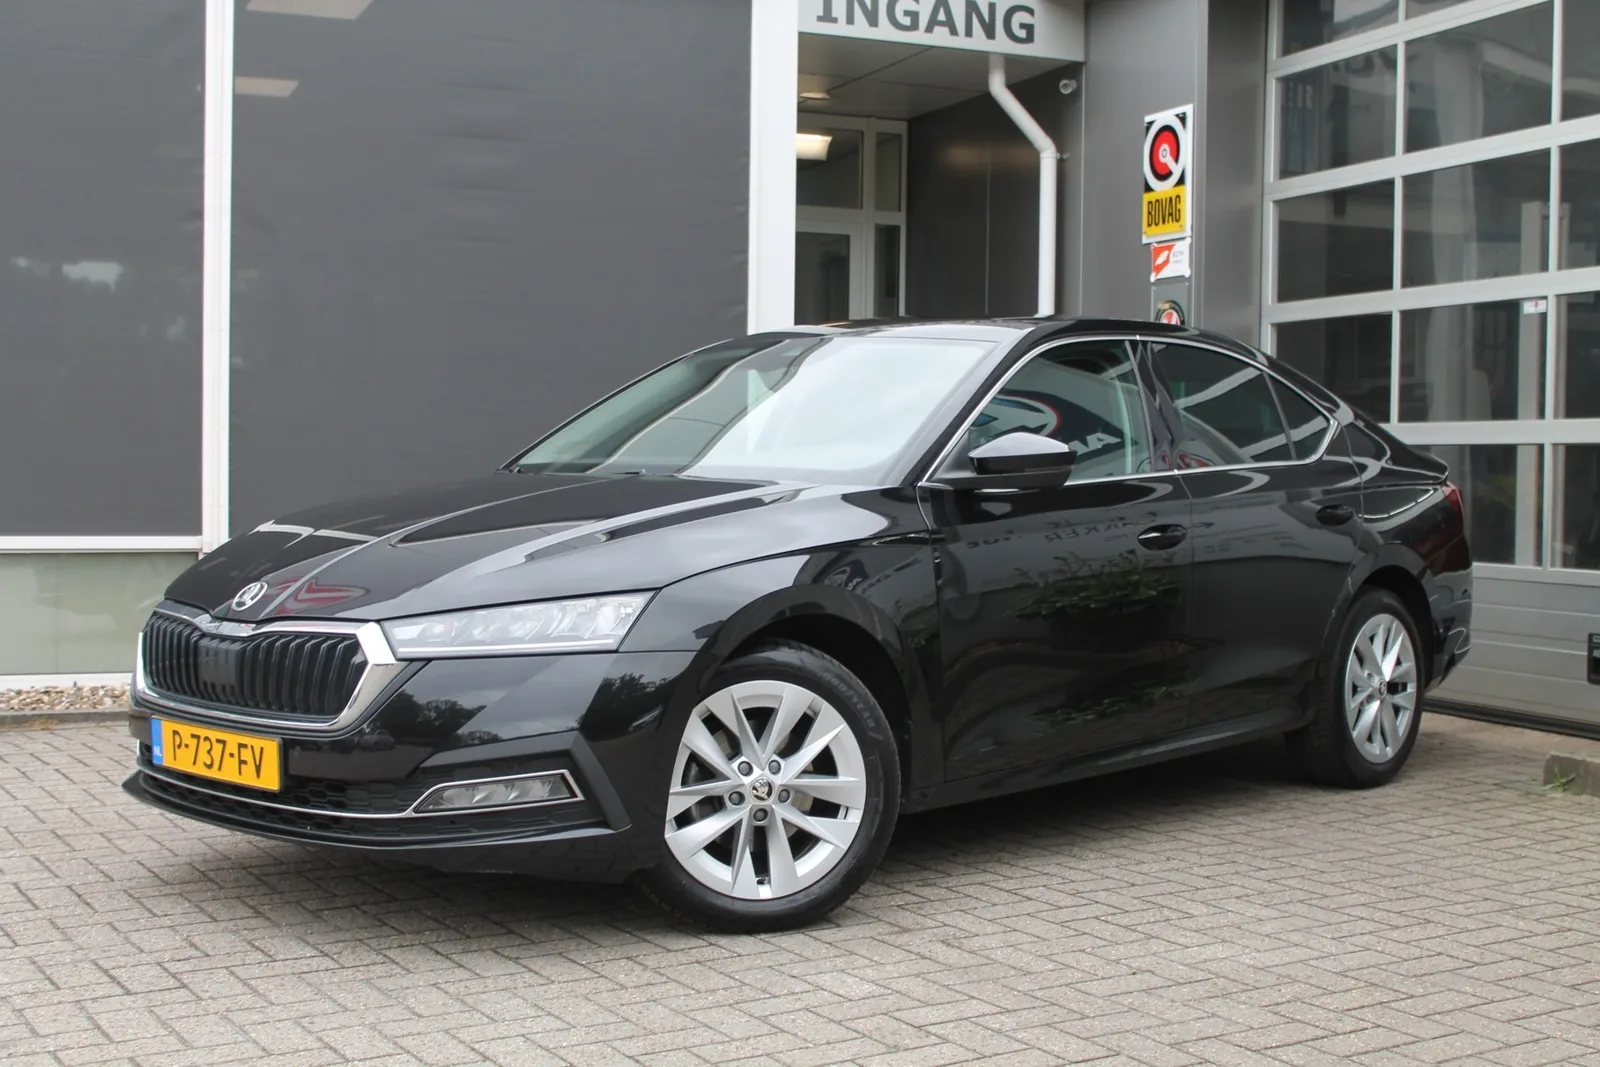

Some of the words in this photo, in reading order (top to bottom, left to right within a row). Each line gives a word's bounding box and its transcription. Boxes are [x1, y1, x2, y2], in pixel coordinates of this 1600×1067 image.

[816, 0, 1035, 44] INGANG
[1147, 194, 1181, 228] BOVAG
[153, 745, 163, 757] NL
[171, 729, 264, 780] P-737-FV
